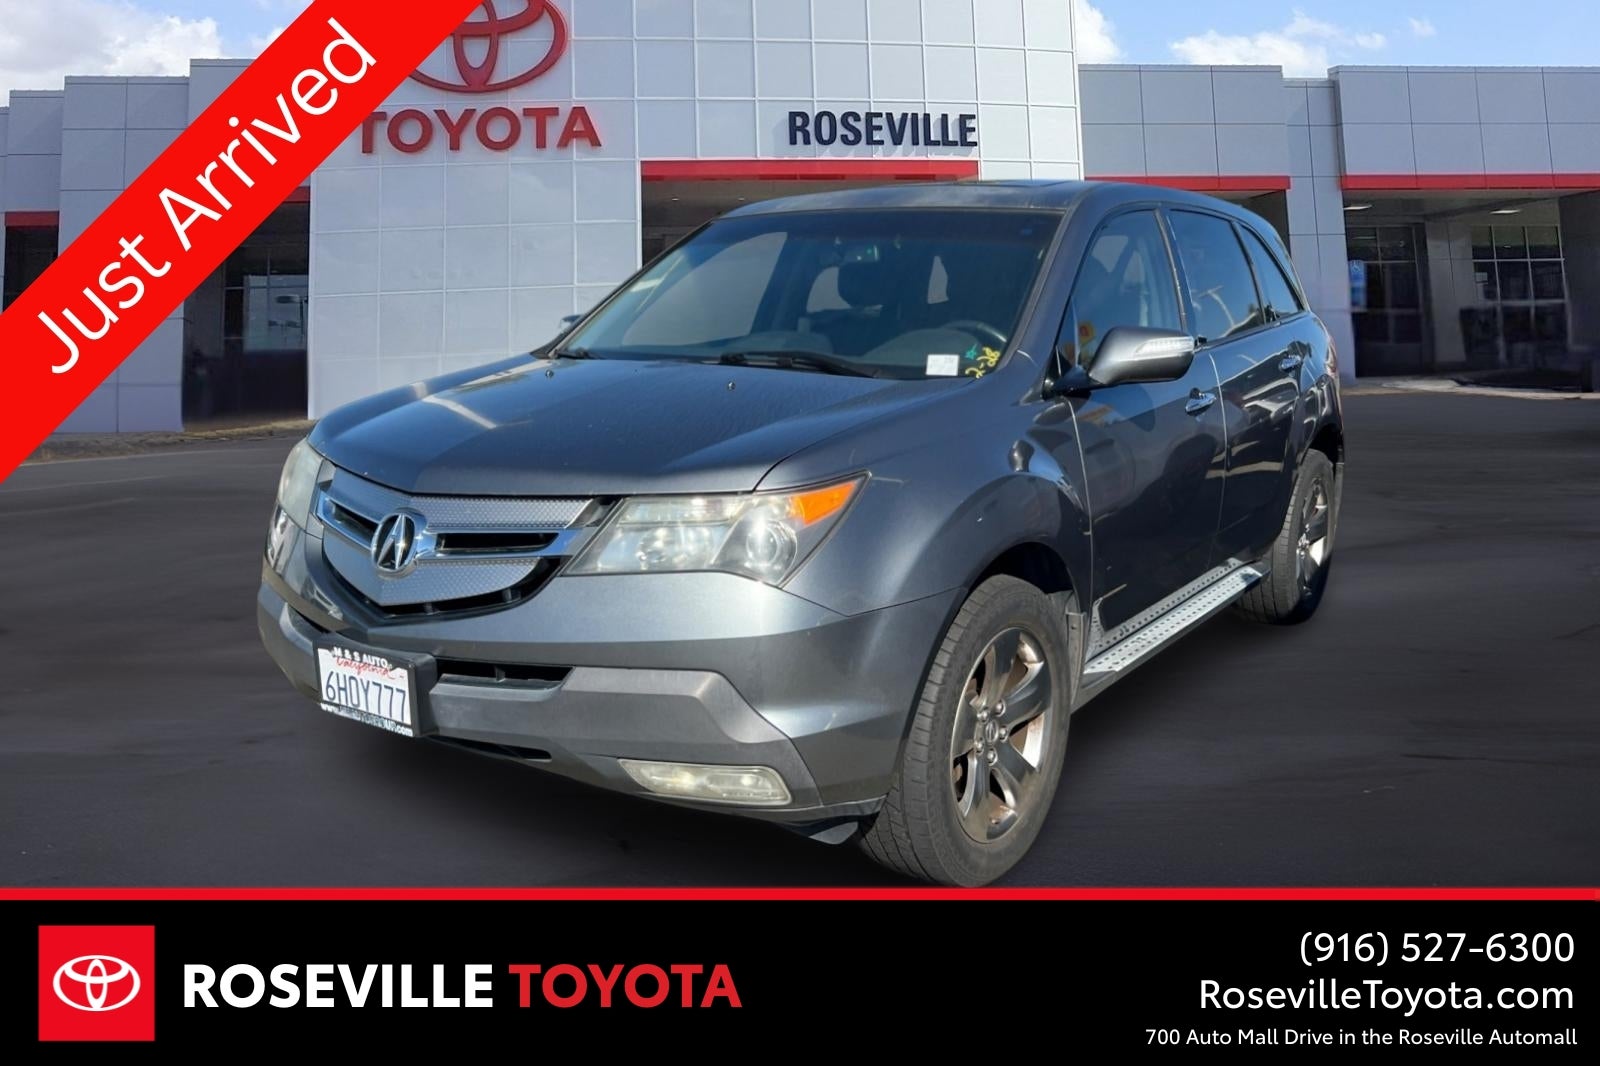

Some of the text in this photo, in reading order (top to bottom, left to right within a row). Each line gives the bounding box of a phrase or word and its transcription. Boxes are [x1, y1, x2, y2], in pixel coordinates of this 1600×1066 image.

[361, 106, 602, 154] TOYOTA
[788, 111, 978, 147] ROSEVILLE
[362, 653, 388, 668] AUTO
